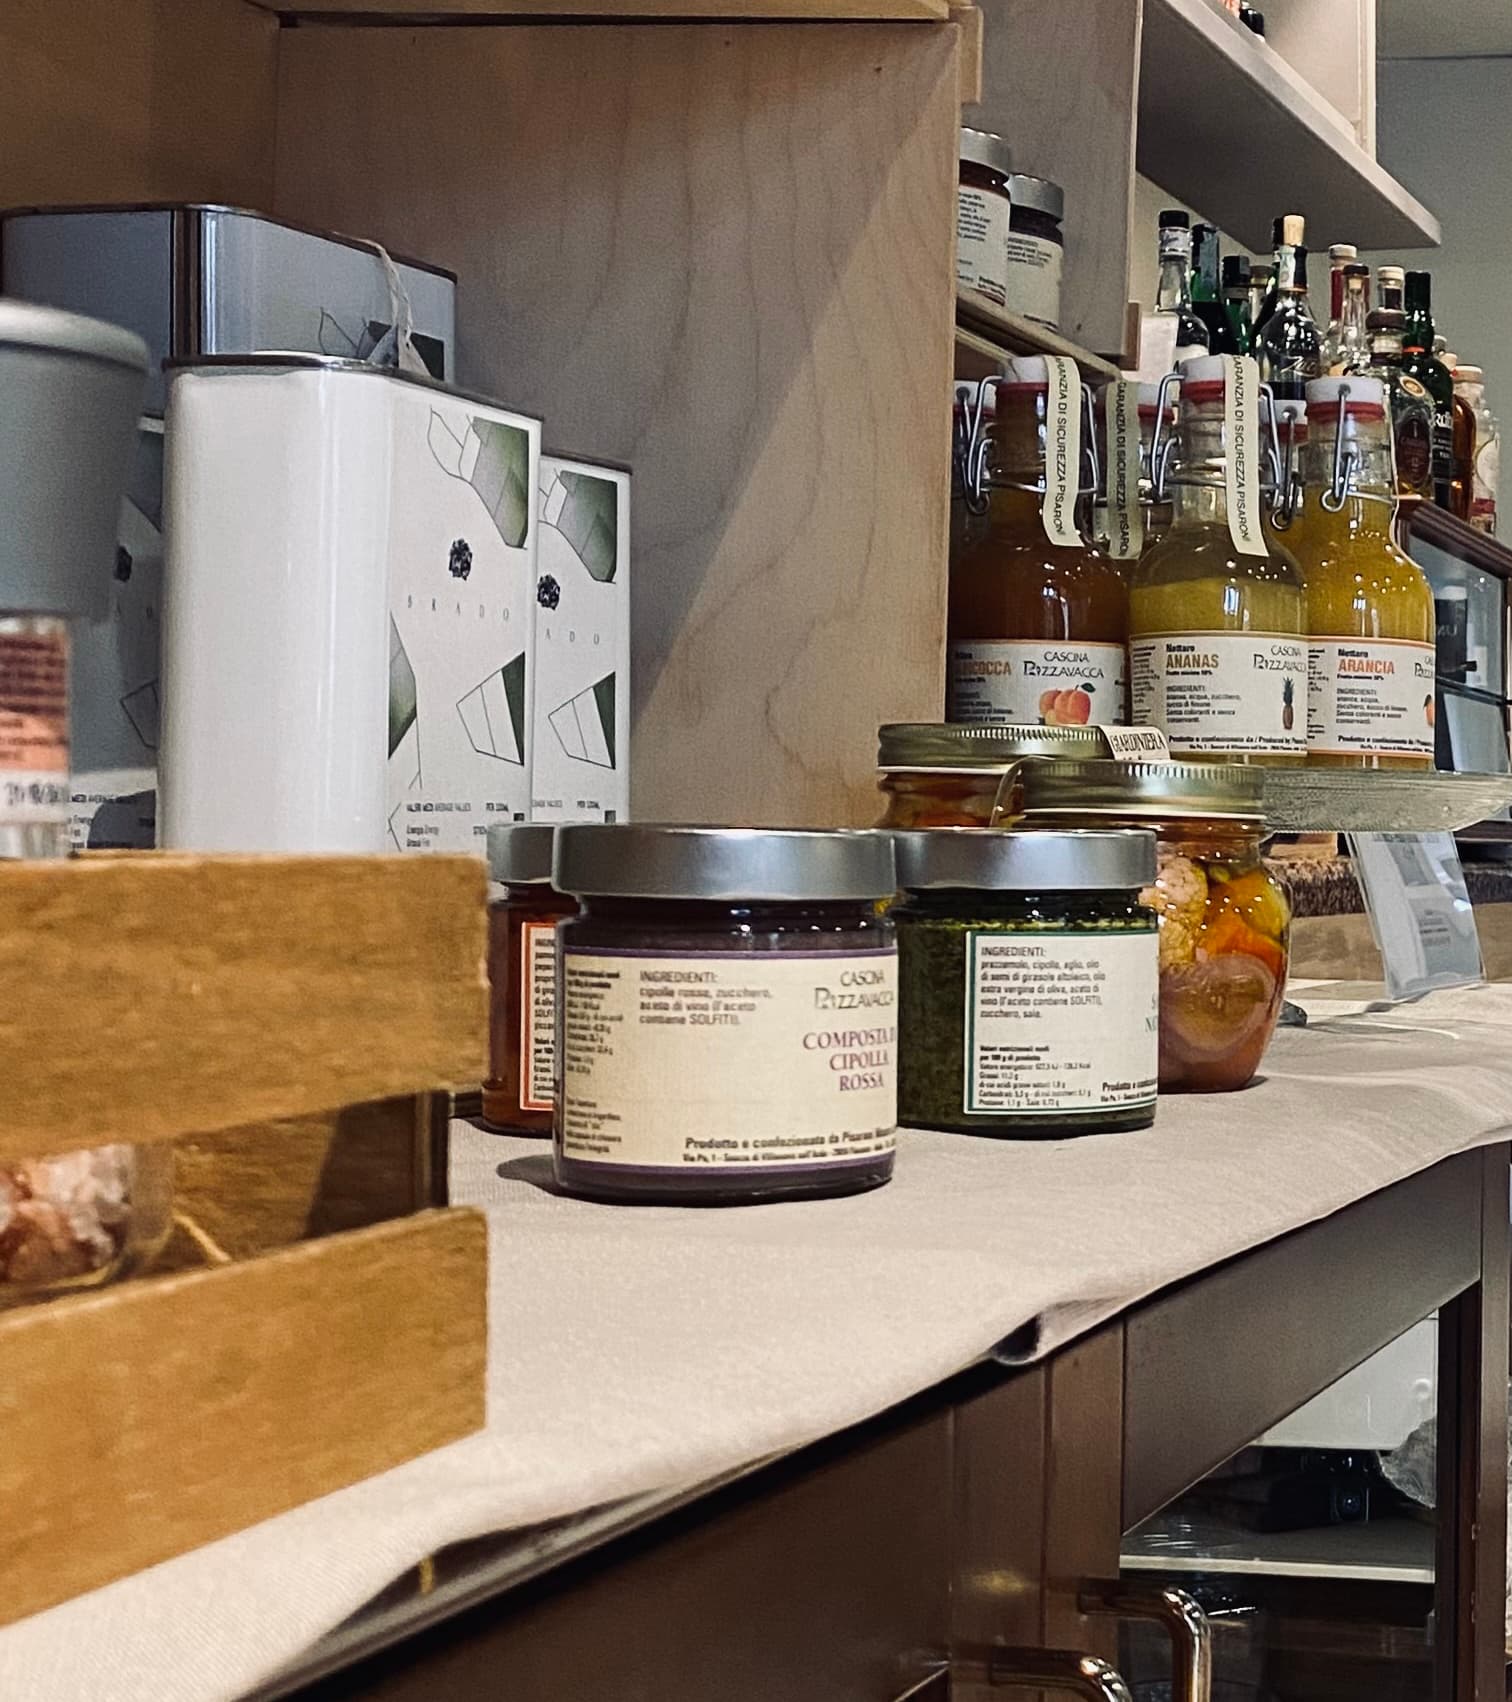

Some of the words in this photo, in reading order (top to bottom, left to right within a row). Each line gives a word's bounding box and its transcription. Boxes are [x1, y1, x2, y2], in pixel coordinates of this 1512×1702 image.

[1058, 402, 1067, 415] DI
[1235, 410, 1244, 422] DI
[1056, 417, 1067, 482] SICUREZZA
[1234, 424, 1246, 490] SICUREZZA
[1044, 651, 1090, 663] CASCINA
[1166, 653, 1220, 669] ANANAS
[1338, 659, 1395, 674] ARANCIA
[639, 970, 718, 983] INGREDIENTI:
[639, 986, 675, 998] cipolla
[715, 987, 773, 999] zucchero,
[980, 1009, 1021, 1019] zucchero,
[802, 1027, 889, 1050] COMPOSTA
[829, 1050, 890, 1071] CIPOLLA
[839, 1072, 885, 1091] ROSSA
[685, 1137, 738, 1149] Prodotto
[753, 1136, 825, 1148] confezionato
[829, 1134, 839, 1144] da
